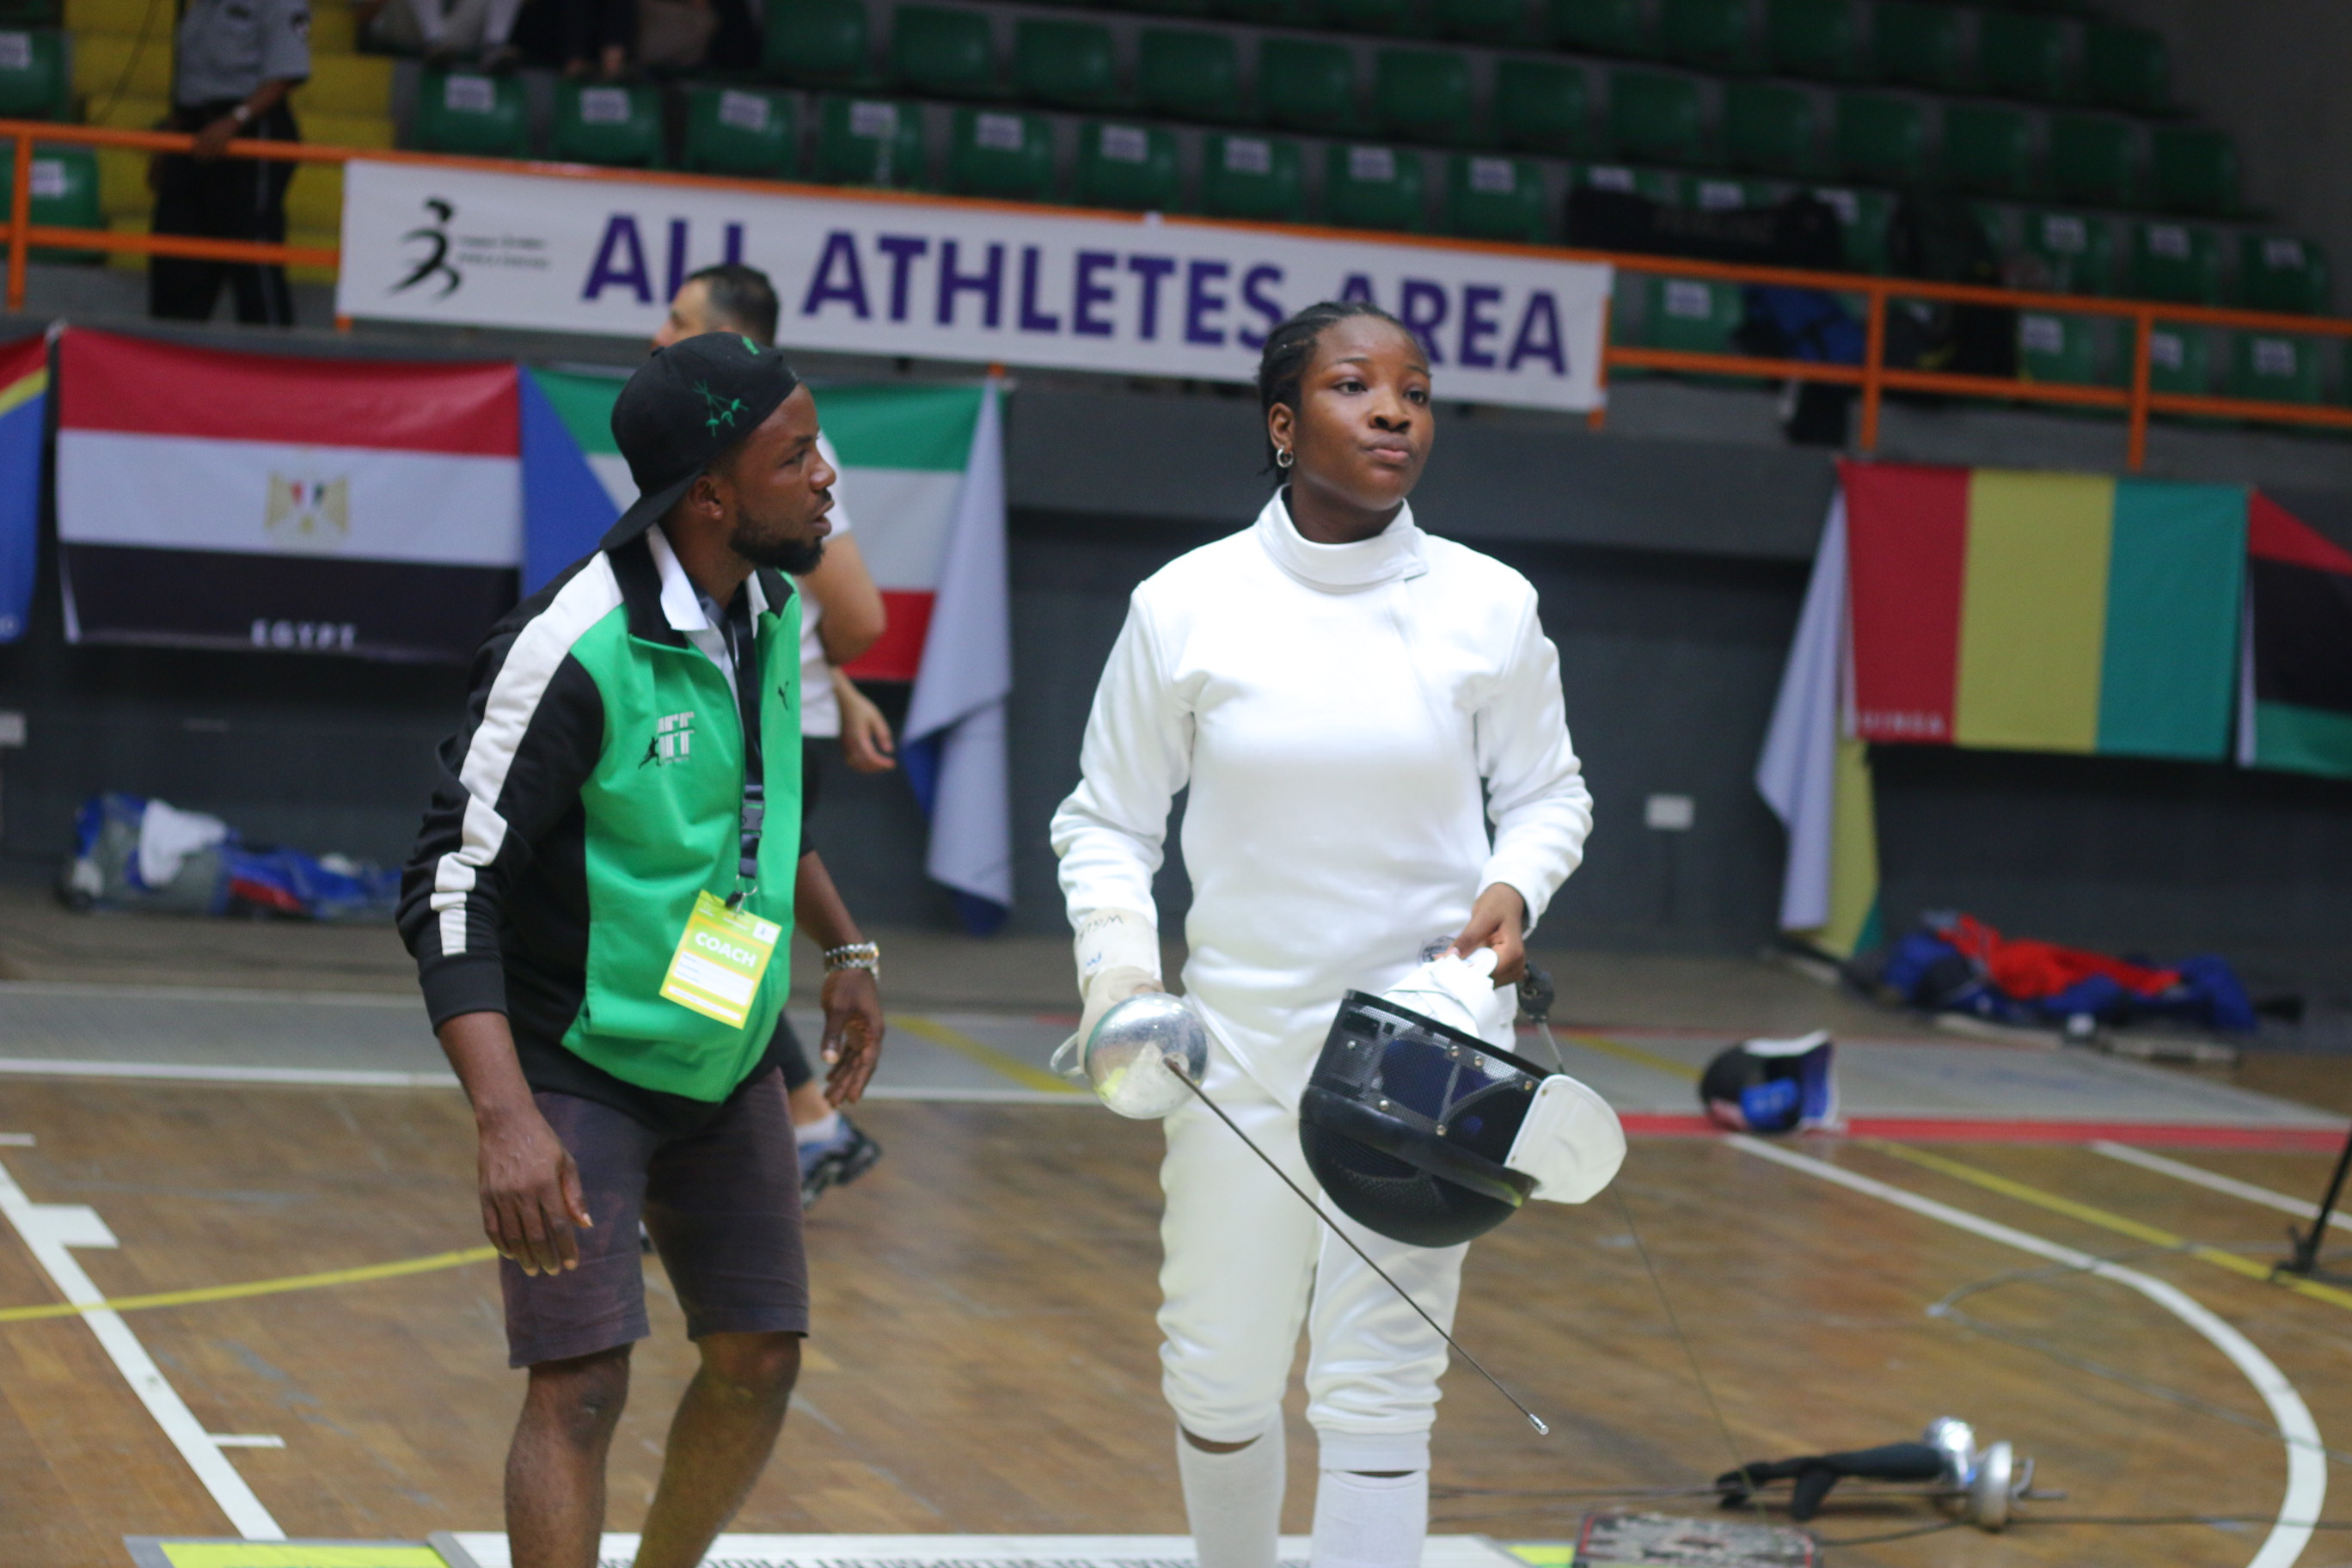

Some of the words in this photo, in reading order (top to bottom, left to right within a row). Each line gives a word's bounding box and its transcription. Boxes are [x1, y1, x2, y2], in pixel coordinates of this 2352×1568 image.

[802, 230, 1285, 351] ATHLETES
[250, 618, 357, 651] EGYPT
[695, 931, 757, 968] COACH
